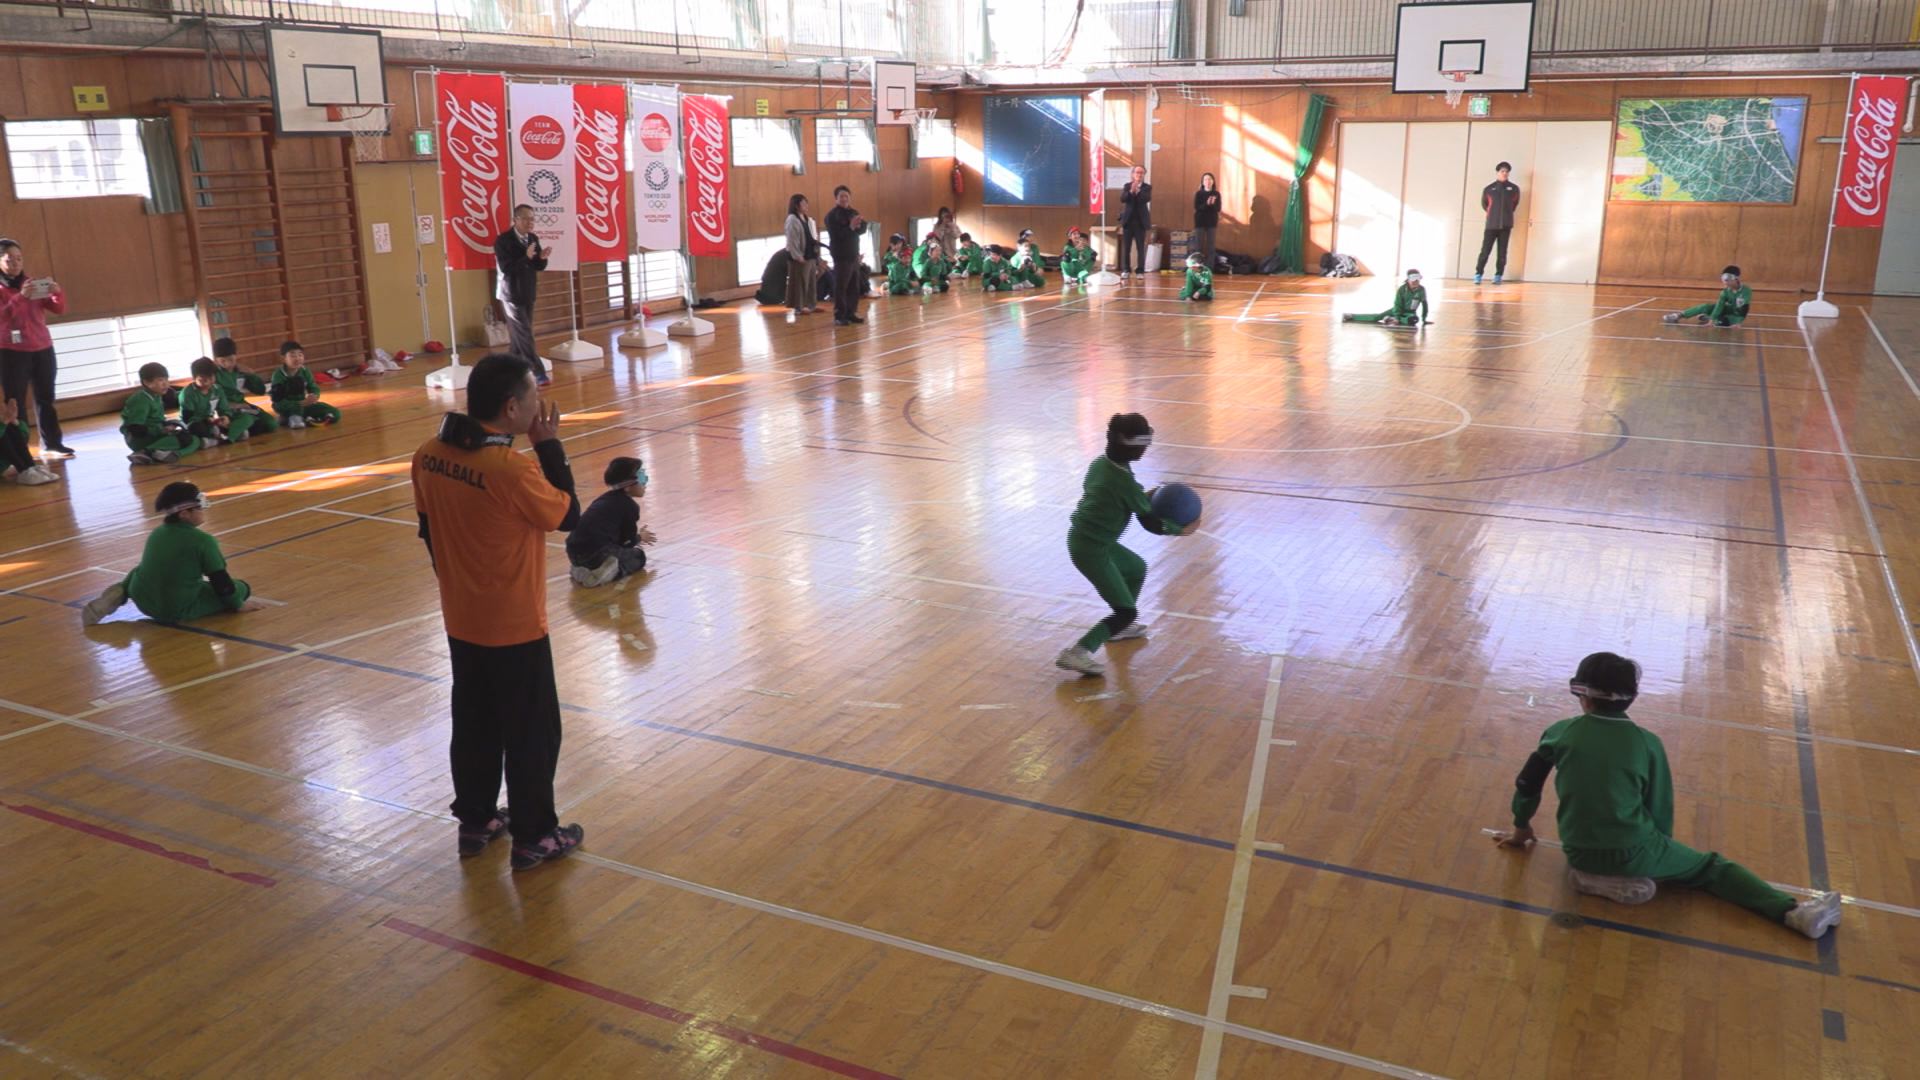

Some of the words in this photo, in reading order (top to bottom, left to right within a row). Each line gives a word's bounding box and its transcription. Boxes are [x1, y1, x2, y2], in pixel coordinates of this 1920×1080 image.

[445, 89, 500, 254] Coca-Cola
[573, 101, 620, 249] Coca-Cola
[689, 109, 725, 243] Coca-Cola
[1843, 89, 1897, 216] Coca-Cola
[421, 454, 487, 491] GOALBALL
